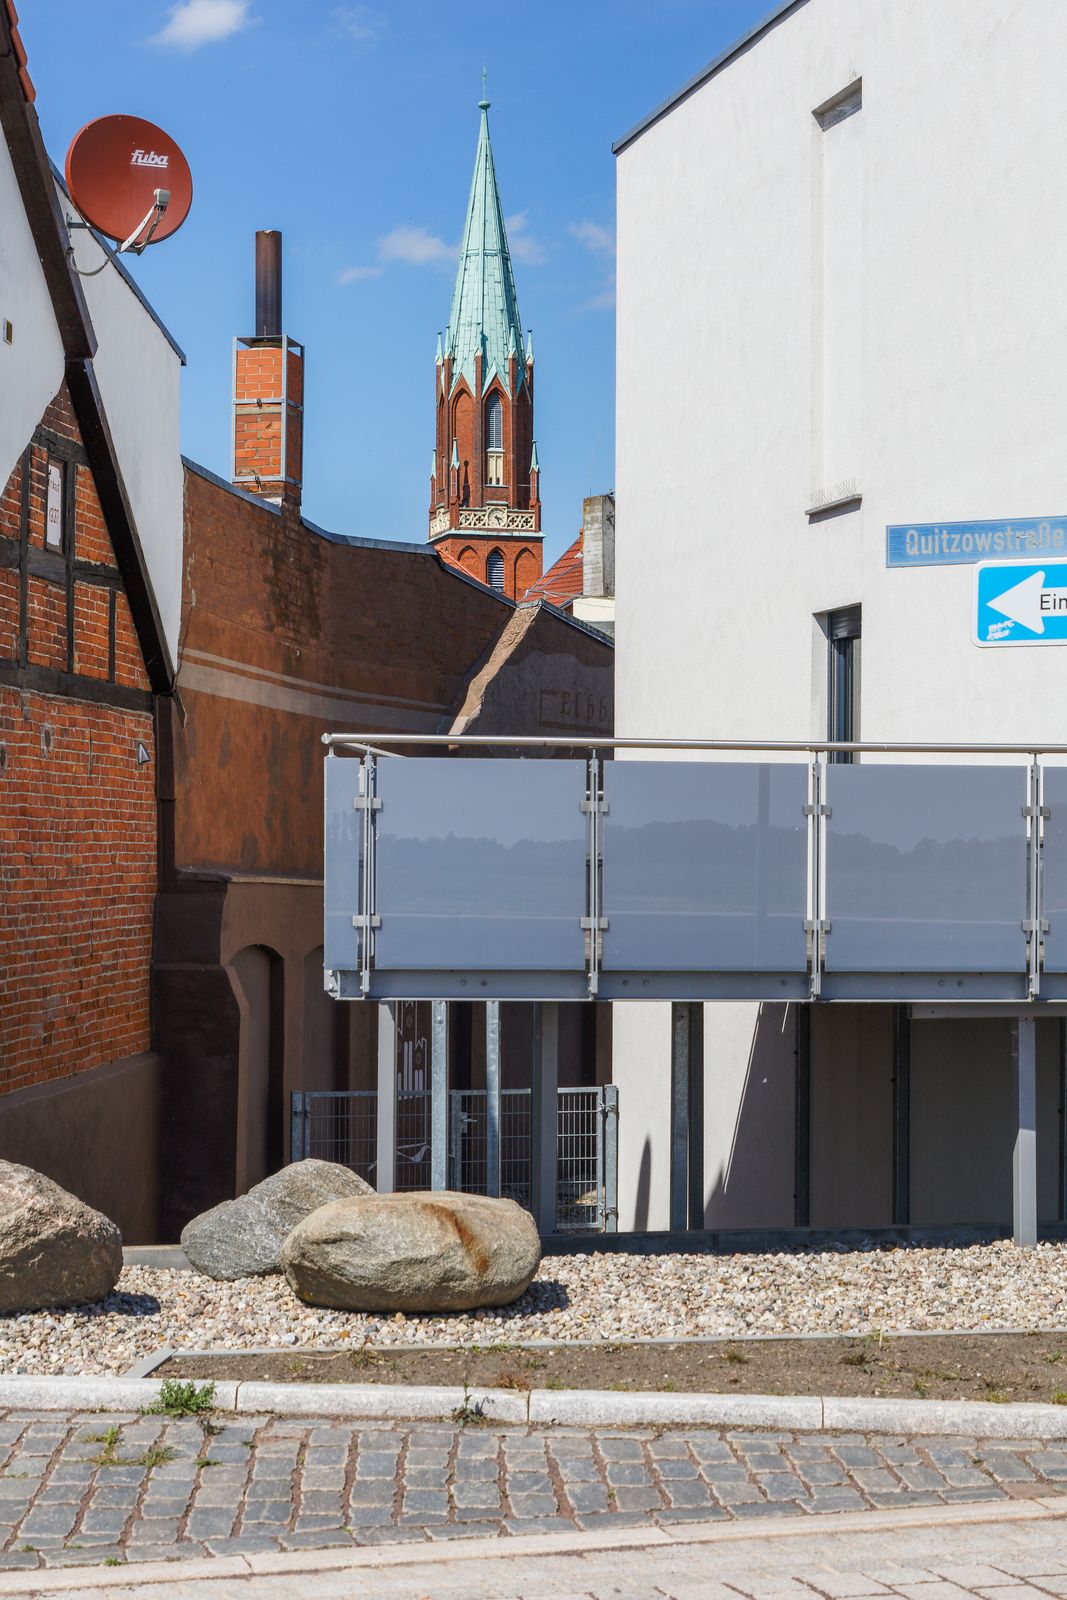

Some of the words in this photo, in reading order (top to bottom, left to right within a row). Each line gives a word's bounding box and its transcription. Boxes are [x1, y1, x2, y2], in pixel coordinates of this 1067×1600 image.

[130, 149, 169, 165] fuba
[905, 522, 1064, 556] Quitzowstraße
[1040, 593, 1067, 610] Ein
